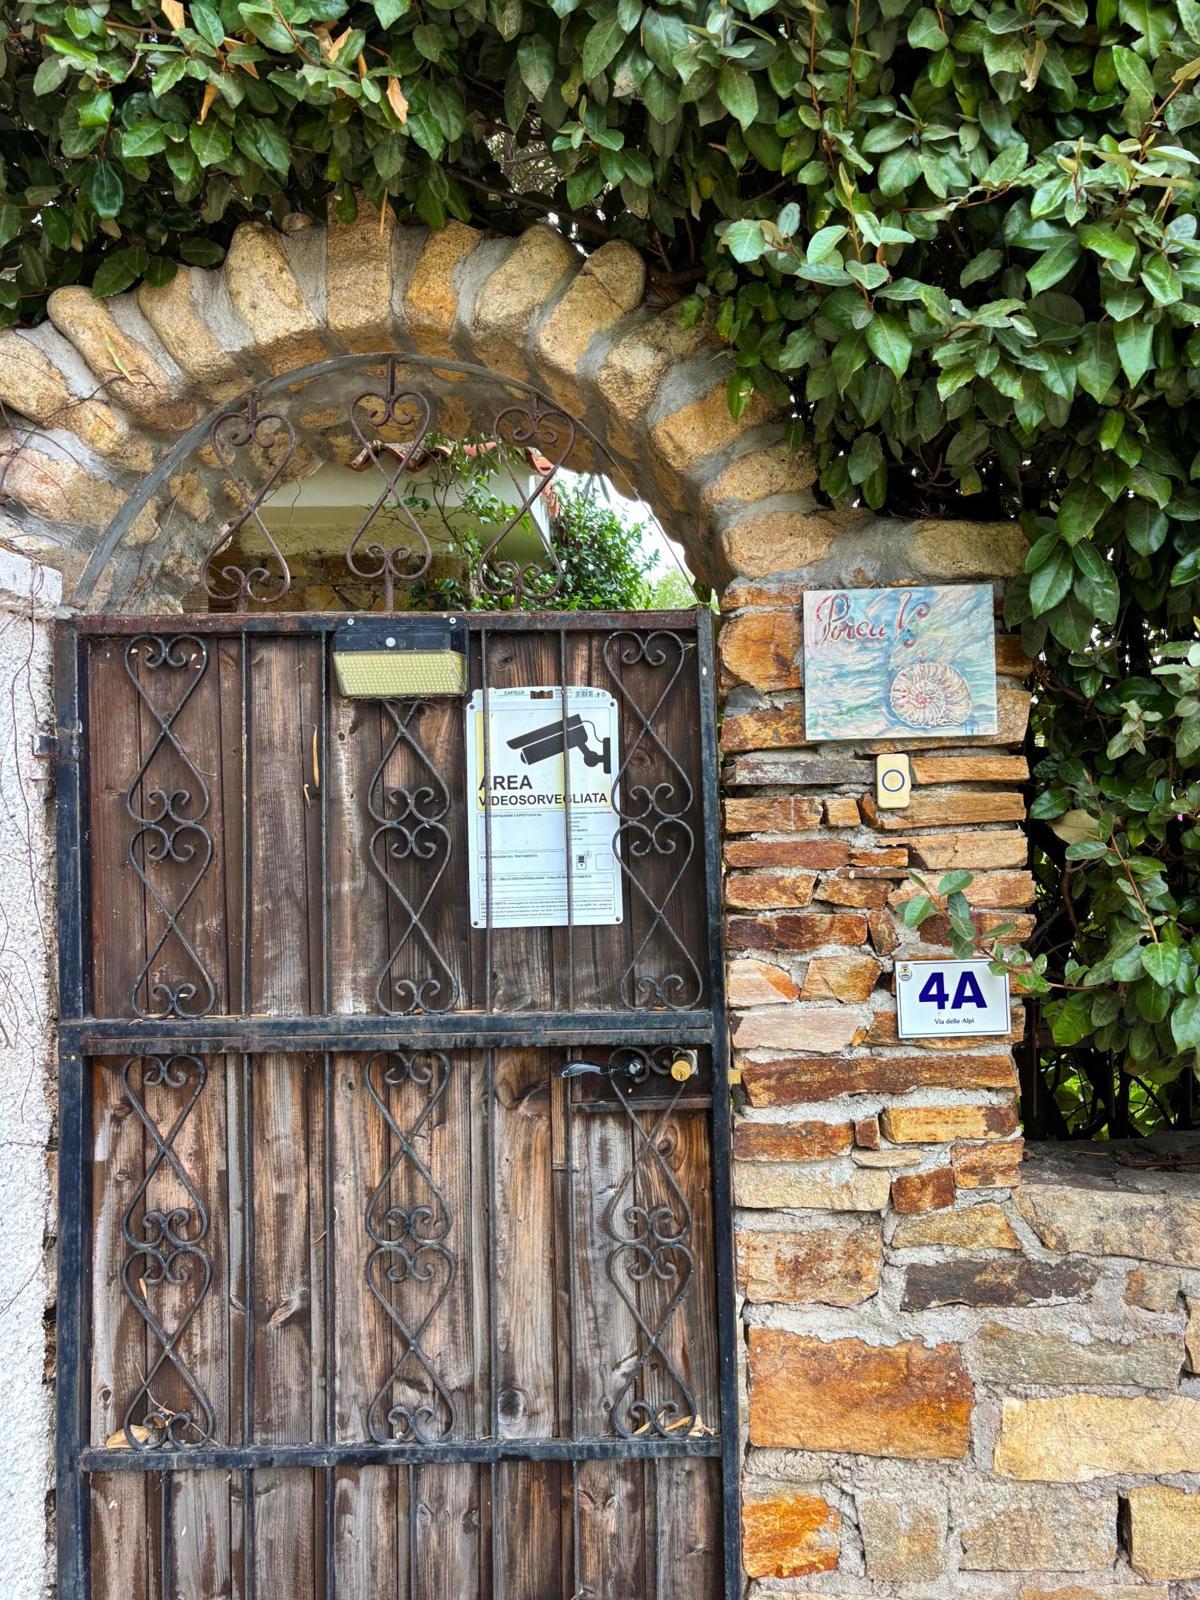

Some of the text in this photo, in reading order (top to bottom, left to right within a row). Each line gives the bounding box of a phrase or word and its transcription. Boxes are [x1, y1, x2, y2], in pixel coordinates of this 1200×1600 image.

[816, 593, 887, 641] Porcu
[478, 792, 608, 807] VDEOSORVEGLIATA
[918, 971, 988, 1010] 4A
[945, 1017, 961, 1025] delle
[962, 1017, 975, 1025] Alpi
